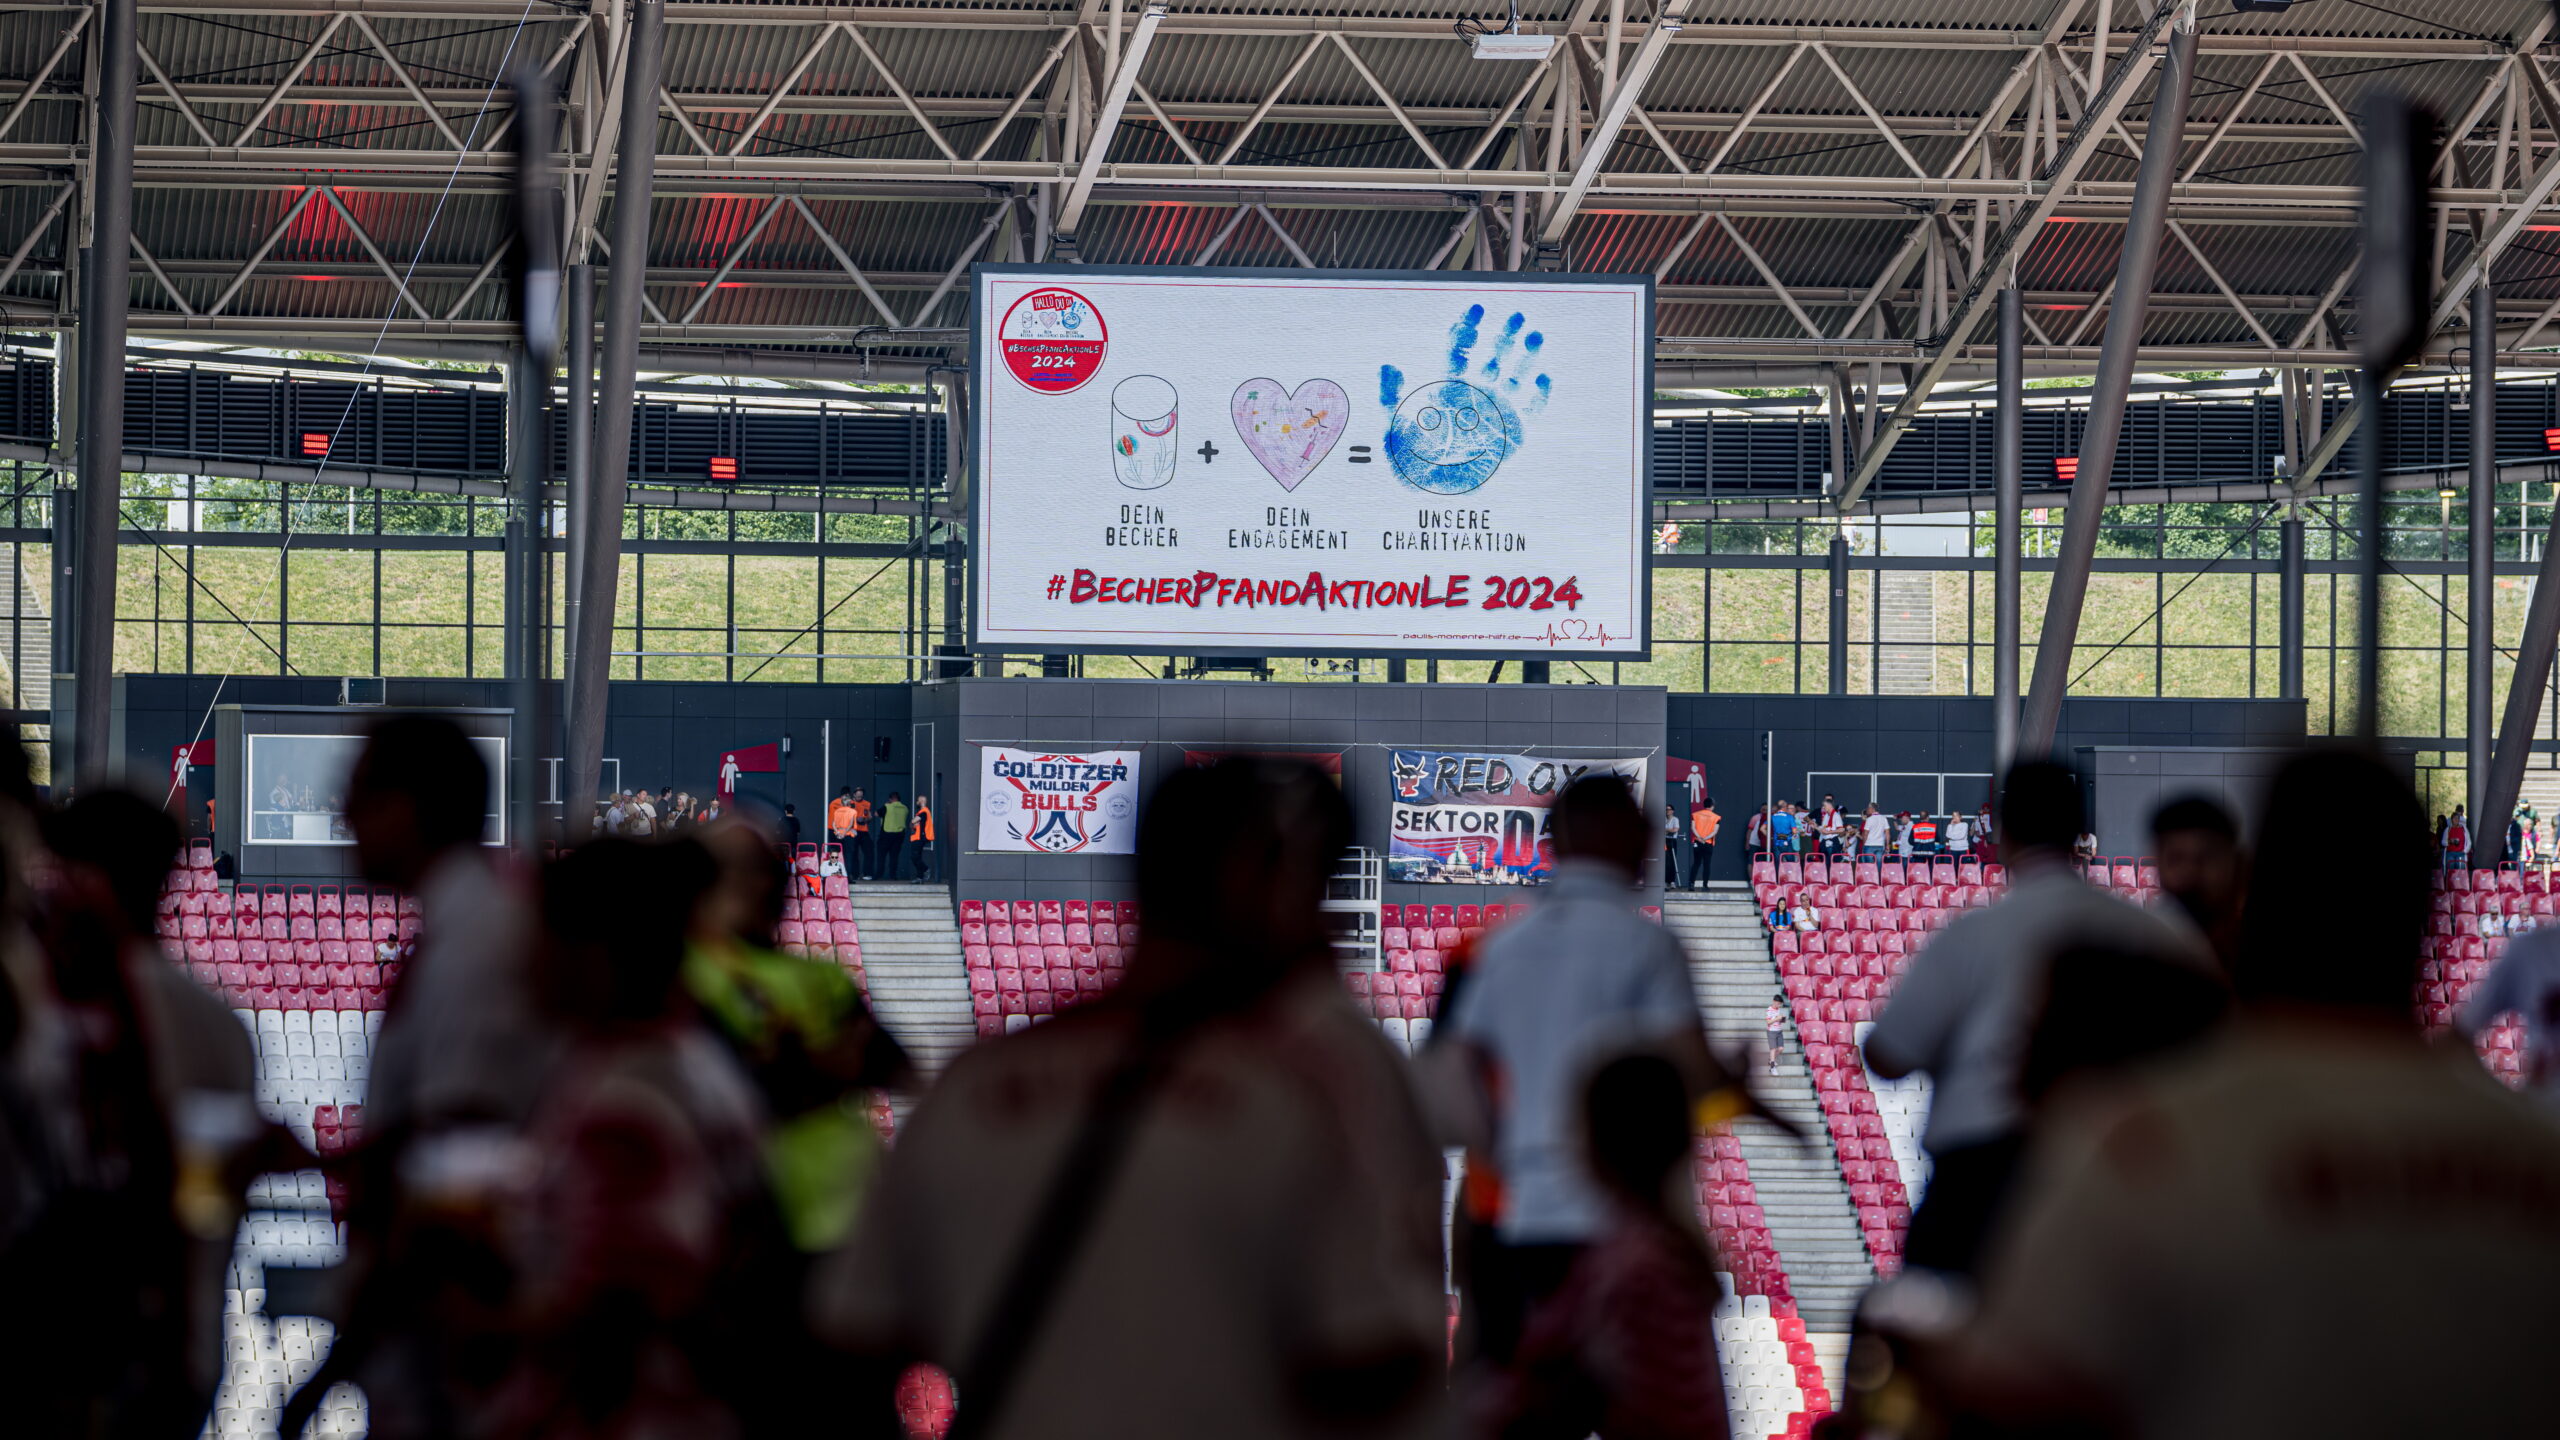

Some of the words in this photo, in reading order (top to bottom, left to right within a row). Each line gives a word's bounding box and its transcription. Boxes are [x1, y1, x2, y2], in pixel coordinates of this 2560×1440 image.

[1031, 355, 1076, 368] 2024
[1121, 504, 1164, 525] DEIN
[1267, 507, 1310, 527] DEIN
[1418, 509, 1491, 530] UNSERE
[1106, 526, 1178, 547] BECHER
[1228, 529, 1348, 550] ENGAGEMENT
[1382, 531, 1526, 552] CHARITYAKTION
[1481, 575, 1583, 611] 2024
[992, 760, 1128, 782] COLDITZER
[1433, 755, 1513, 797] RED
[1029, 780, 1090, 792] MULDEN
[1021, 792, 1098, 812] BULLS
[1394, 809, 1499, 834] SEKTOR
